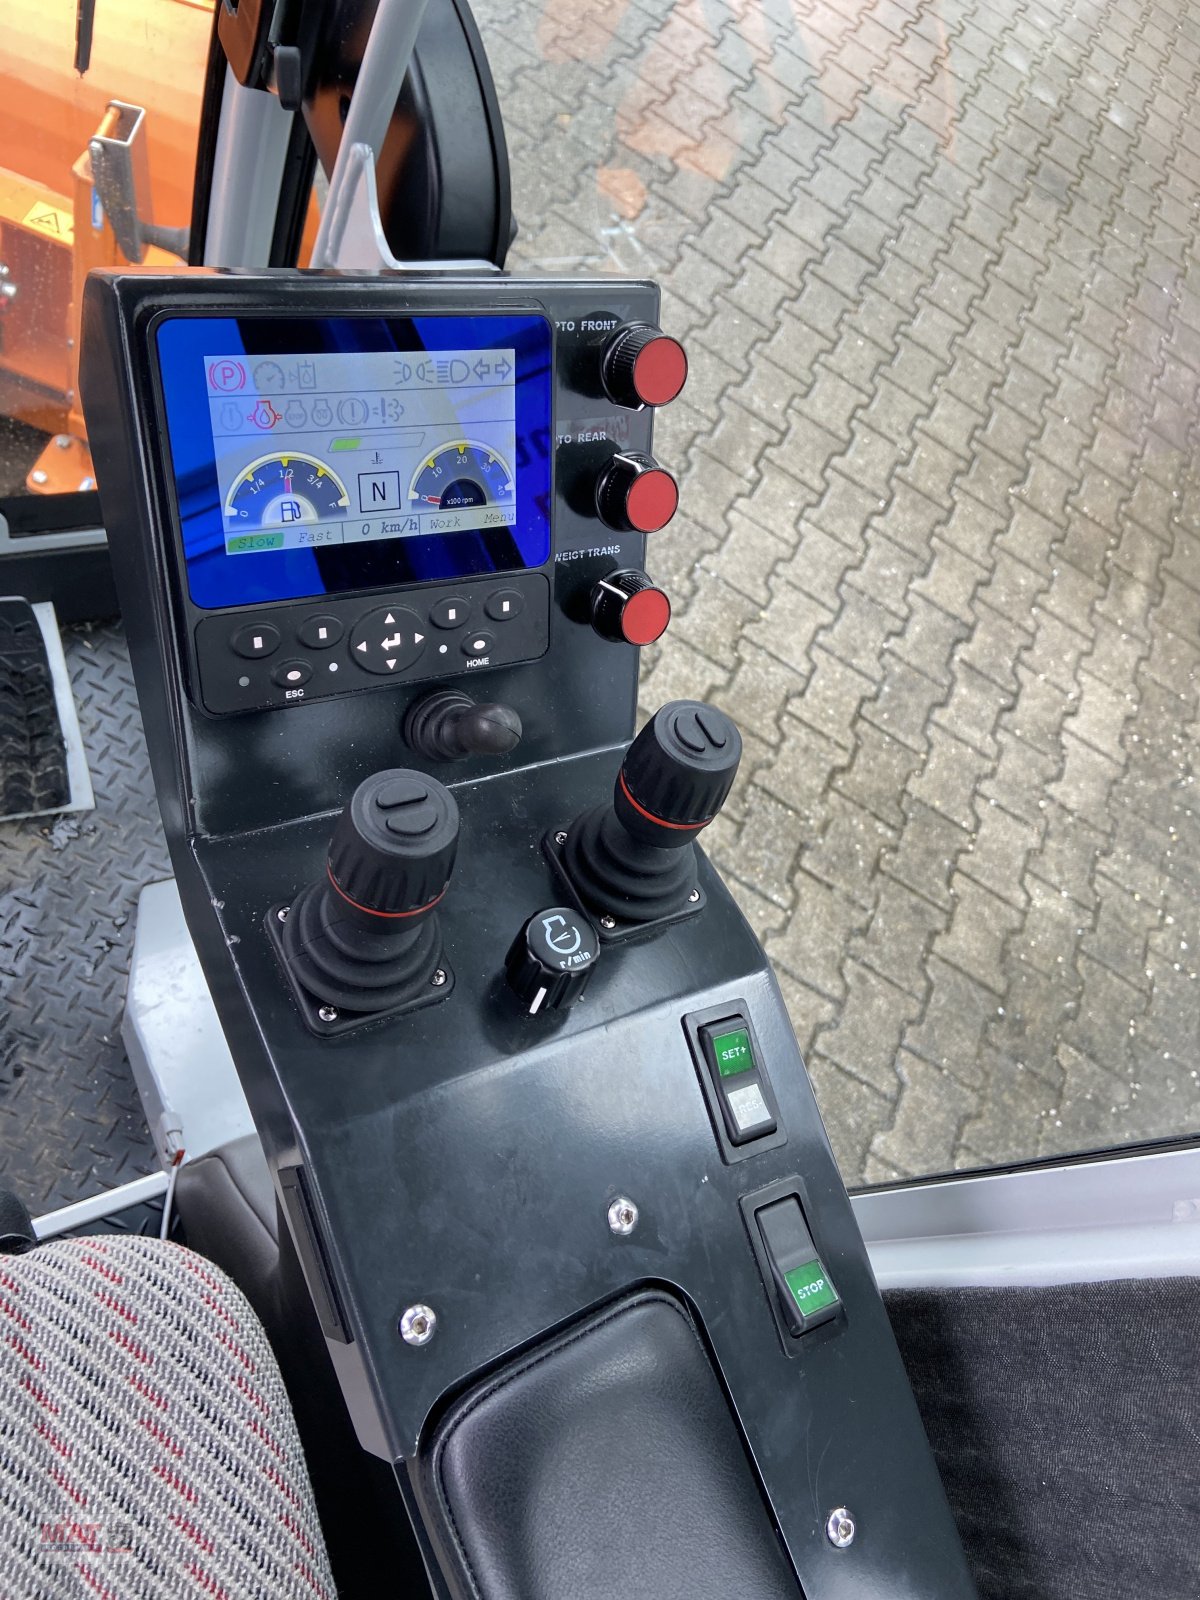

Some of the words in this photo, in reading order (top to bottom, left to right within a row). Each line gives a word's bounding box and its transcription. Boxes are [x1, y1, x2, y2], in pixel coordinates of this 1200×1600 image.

[581, 320, 617, 331] FRONT
[222, 367, 235, 386] P
[556, 434, 572, 444] TO
[577, 431, 607, 443] REAR
[456, 455, 468, 464] 20
[279, 469, 295, 479] 1/2
[432, 466, 444, 478] 10
[480, 462, 491, 473] 30
[250, 478, 265, 495] 1/4
[306, 474, 323, 489] 3/4
[372, 481, 386, 502] N
[461, 496, 474, 505] rpm
[238, 536, 275, 549] Slow
[298, 530, 333, 542] Fast
[361, 523, 371, 536] 0
[381, 517, 419, 535] km/h
[430, 516, 461, 530] Work
[484, 512, 515, 525] Menu
[588, 545, 621, 558] TRANS
[466, 657, 490, 668] HOME
[285, 688, 305, 699] ESC
[559, 950, 591, 969] r/min
[721, 1046, 747, 1061] SET+
[797, 1279, 824, 1299] STOP
